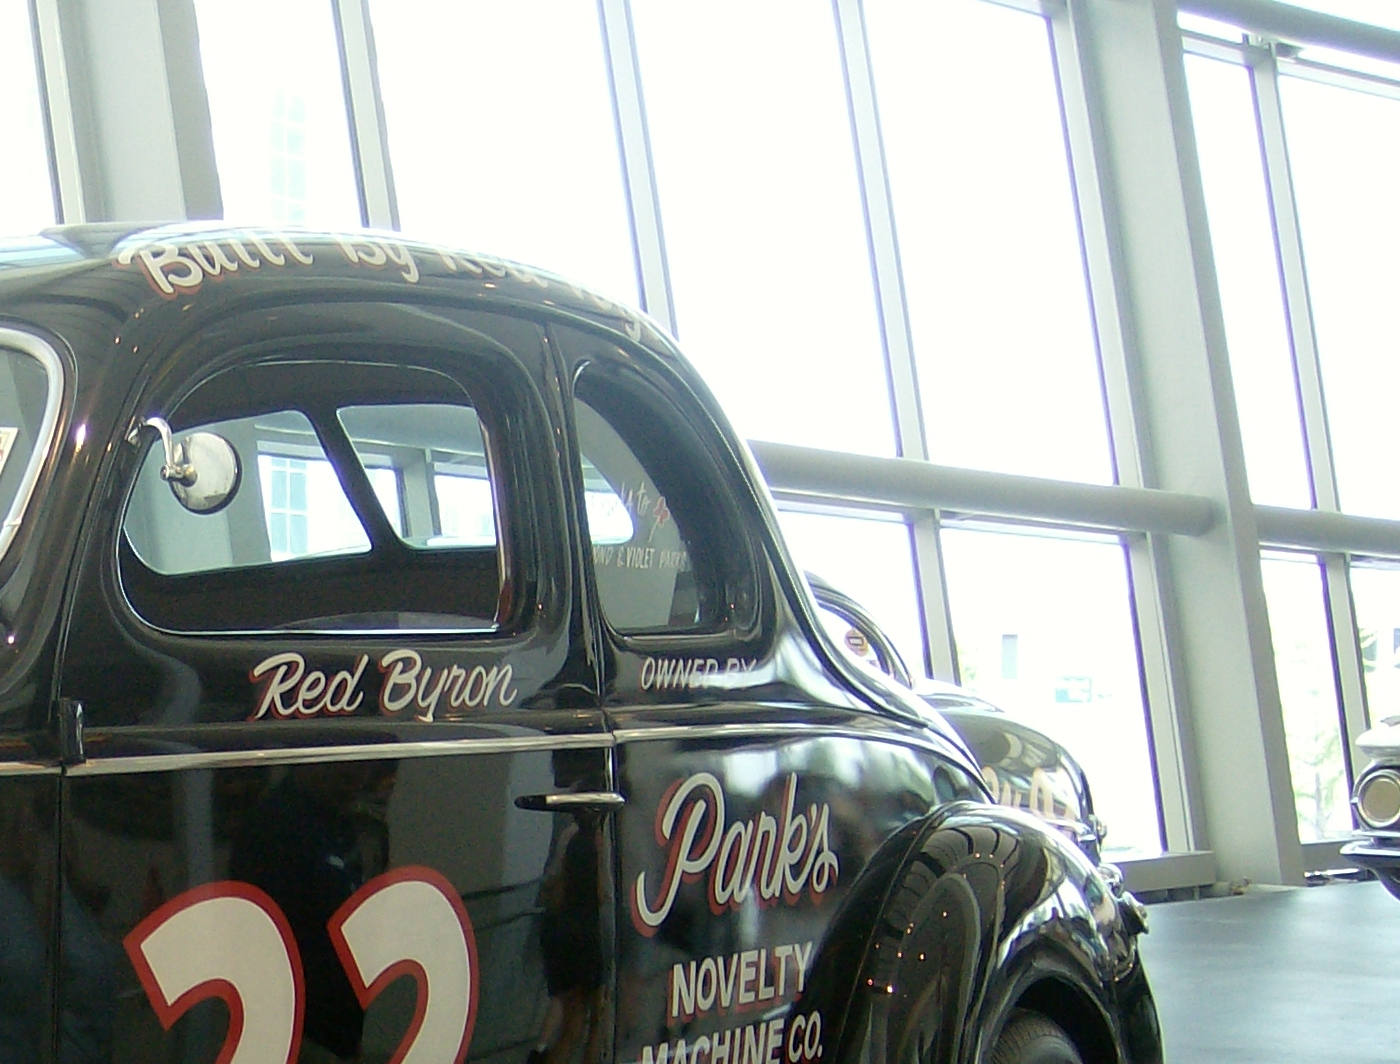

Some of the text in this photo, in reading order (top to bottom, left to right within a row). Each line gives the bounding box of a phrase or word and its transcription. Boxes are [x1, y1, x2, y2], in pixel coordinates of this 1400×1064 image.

[117, 229, 314, 297] Built
[251, 649, 518, 723] Red Byron
[640, 656, 719, 691] OWNED
[669, 940, 813, 1020] NOVELTY
[786, 1010, 824, 1064] CO.
